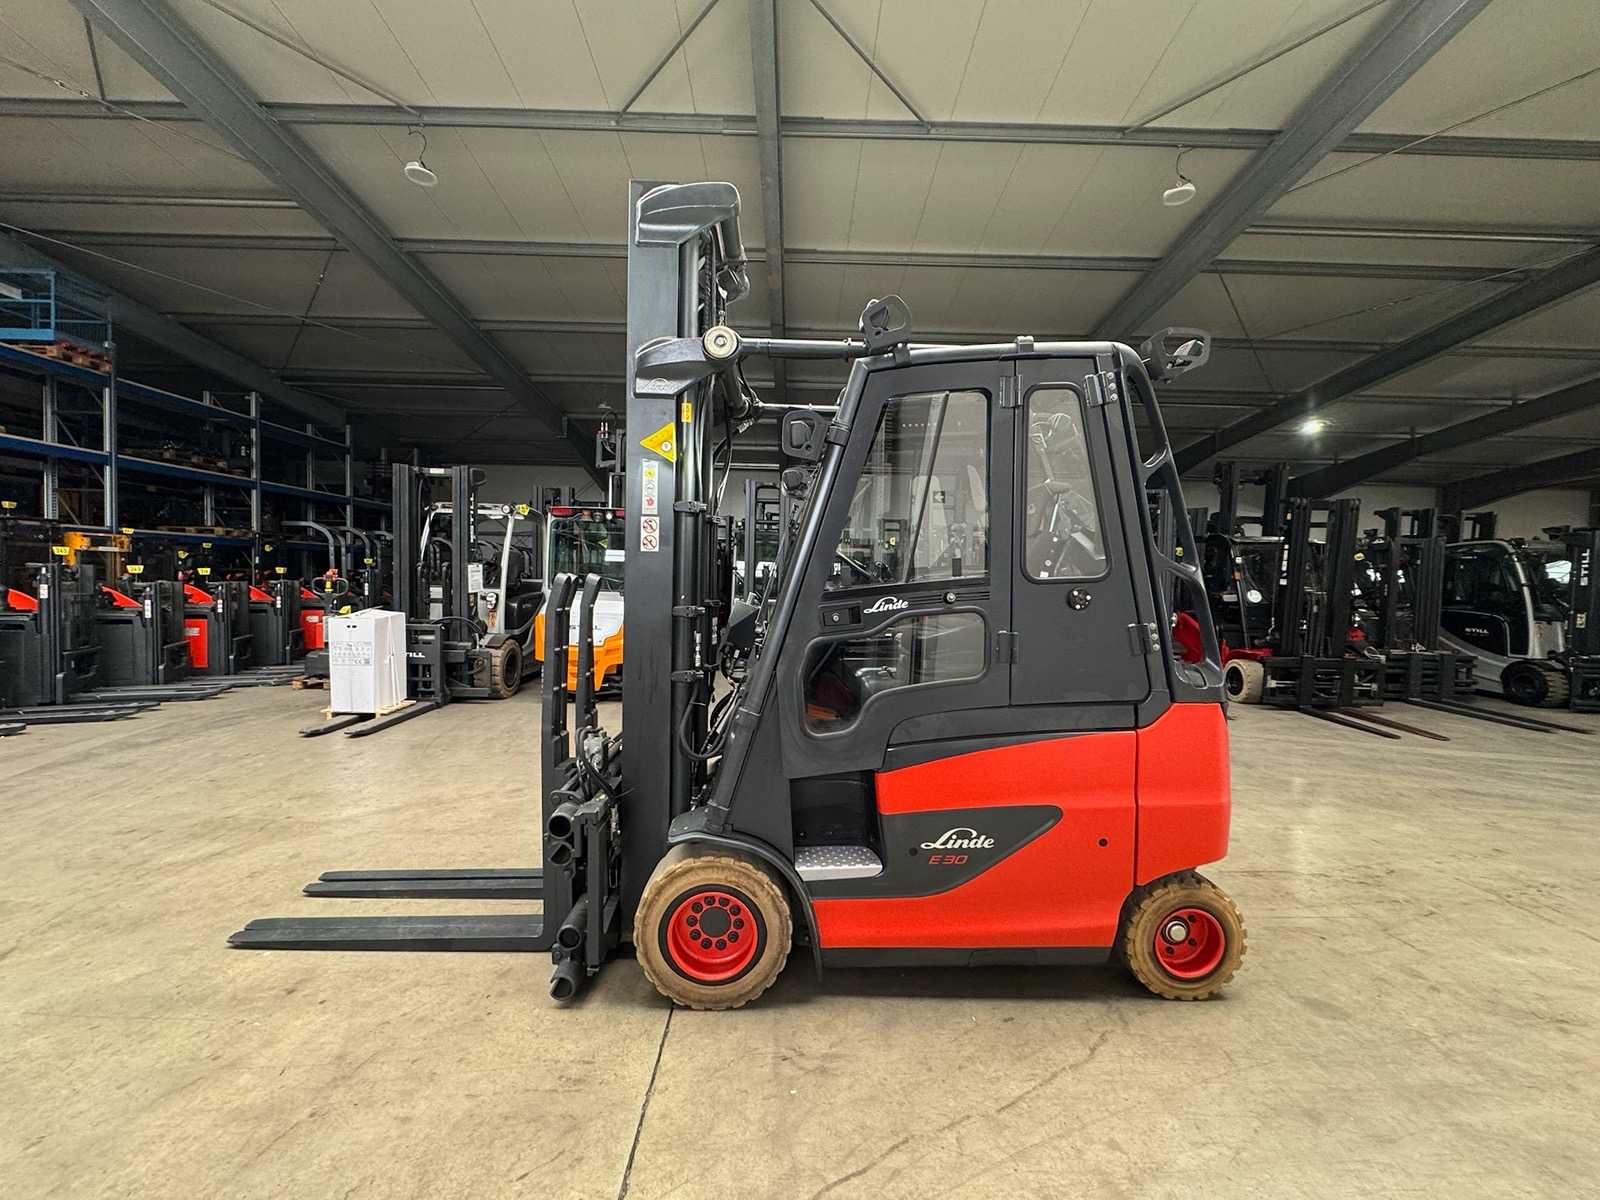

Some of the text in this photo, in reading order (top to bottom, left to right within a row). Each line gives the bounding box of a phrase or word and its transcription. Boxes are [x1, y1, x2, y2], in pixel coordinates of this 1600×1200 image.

[1580, 549, 1589, 586] STILL
[863, 596, 909, 613] Linde
[920, 827, 995, 850] Linde
